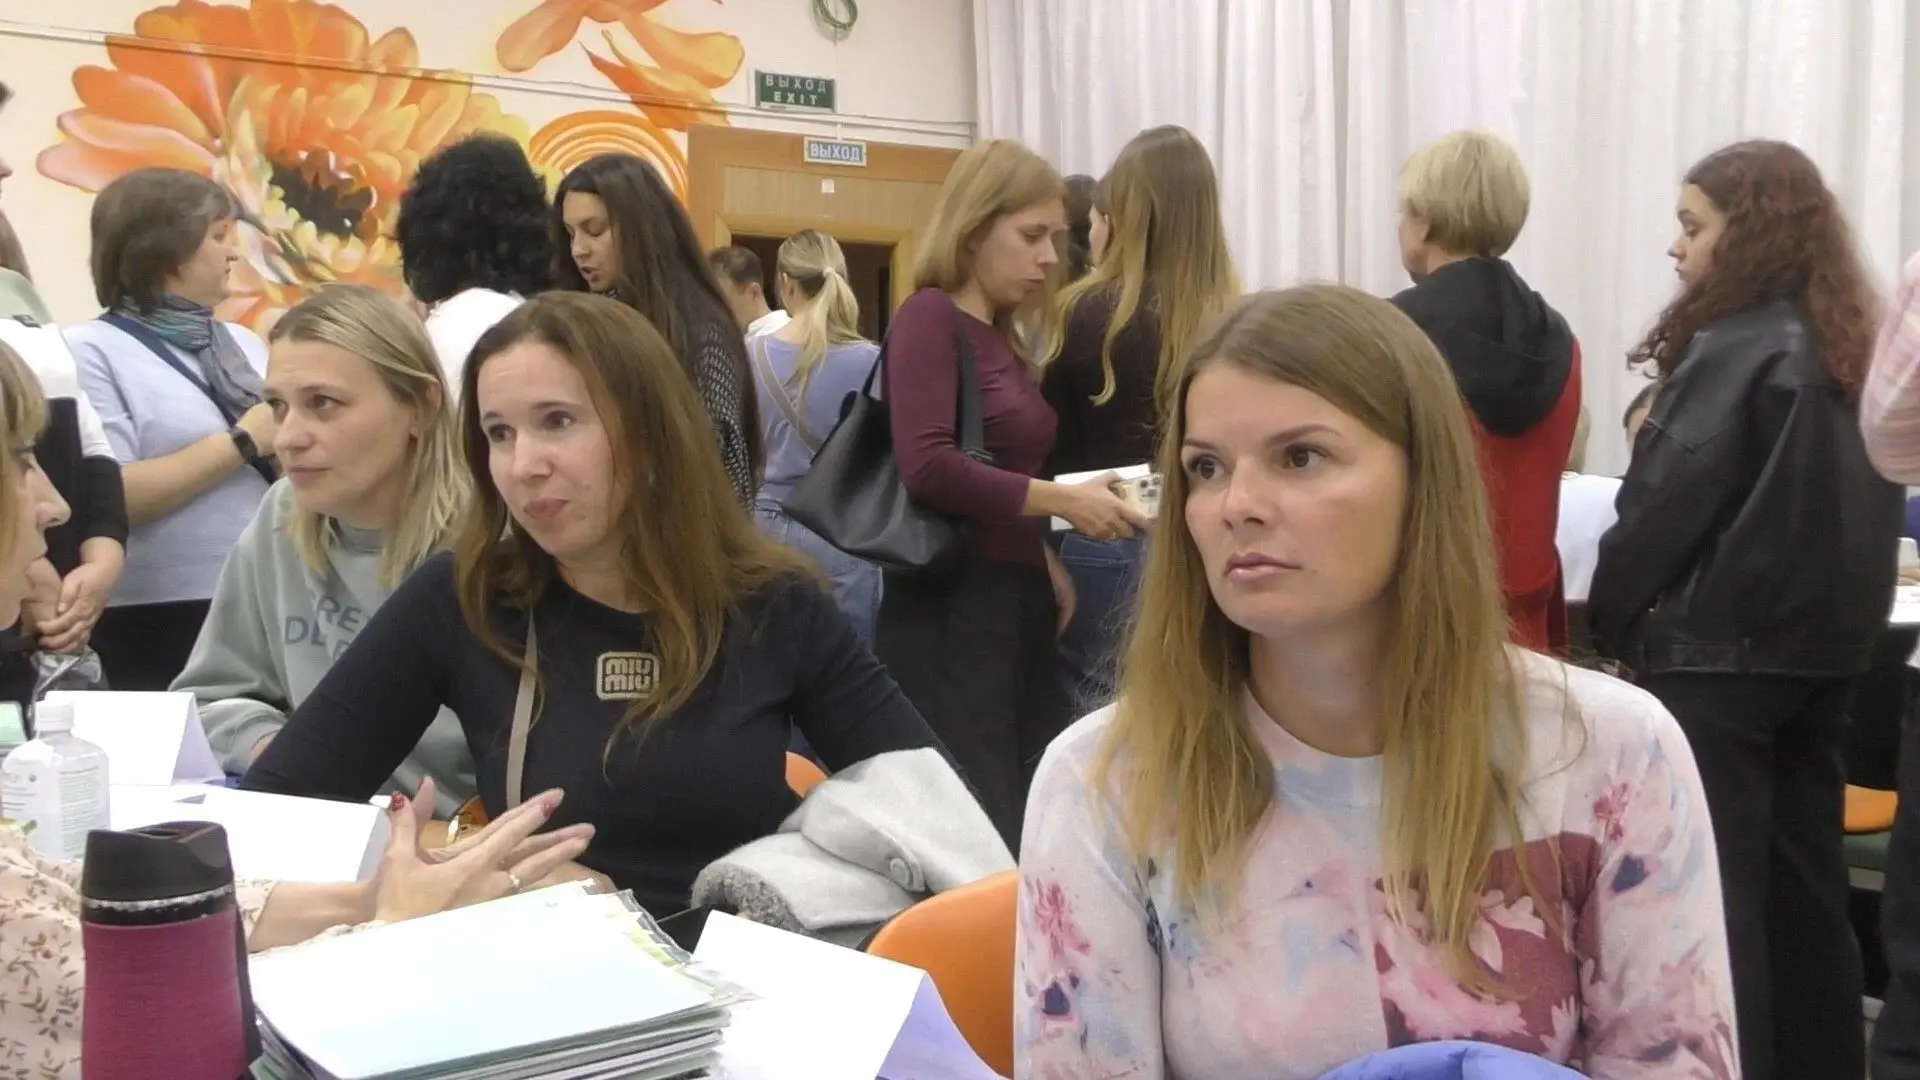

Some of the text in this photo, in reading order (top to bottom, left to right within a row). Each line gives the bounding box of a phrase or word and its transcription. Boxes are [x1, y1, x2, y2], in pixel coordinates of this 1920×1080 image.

[765, 74, 827, 93] ВЫХОД
[773, 91, 818, 105] EXIT
[809, 143, 861, 162] ВЫХОД
[605, 658, 652, 674] miu
[605, 674, 652, 692] miu
